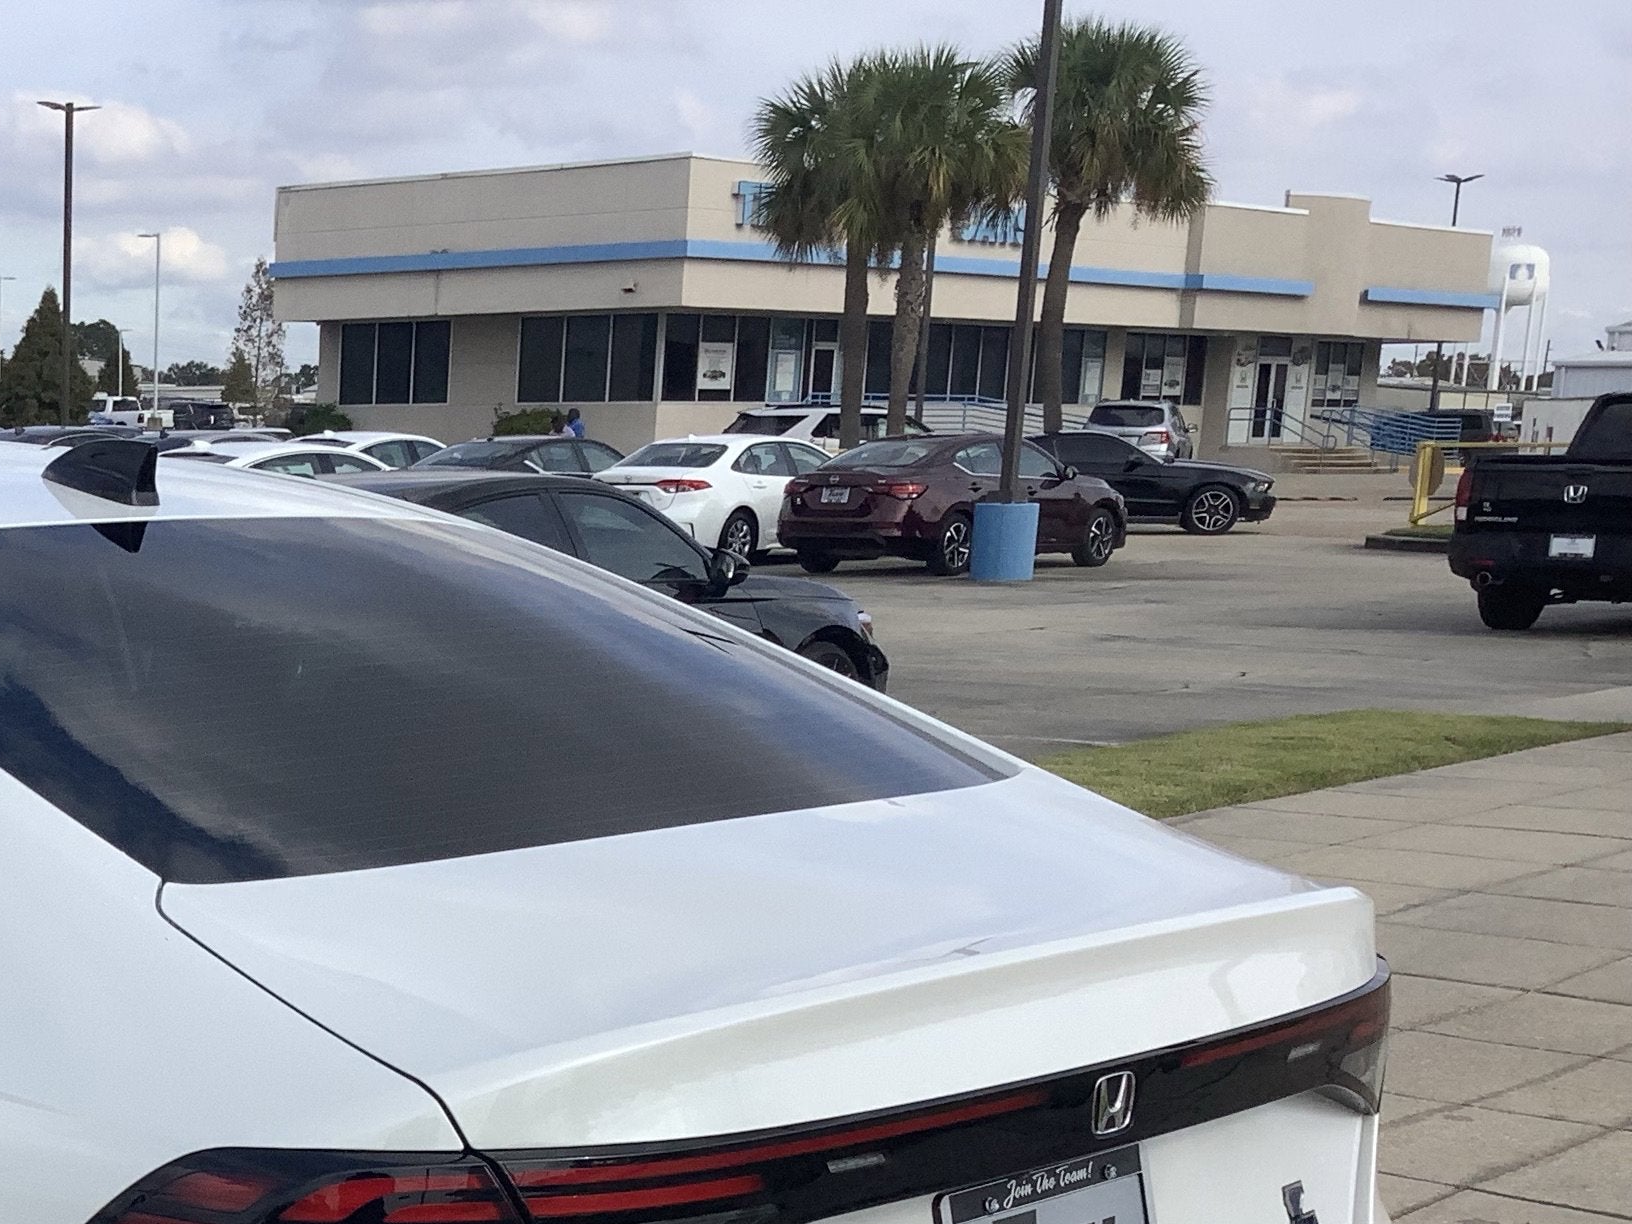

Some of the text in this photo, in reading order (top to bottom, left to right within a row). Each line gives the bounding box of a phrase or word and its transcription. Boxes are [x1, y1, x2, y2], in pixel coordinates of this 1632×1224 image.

[1003, 1161, 1094, 1209] Join The Team!
